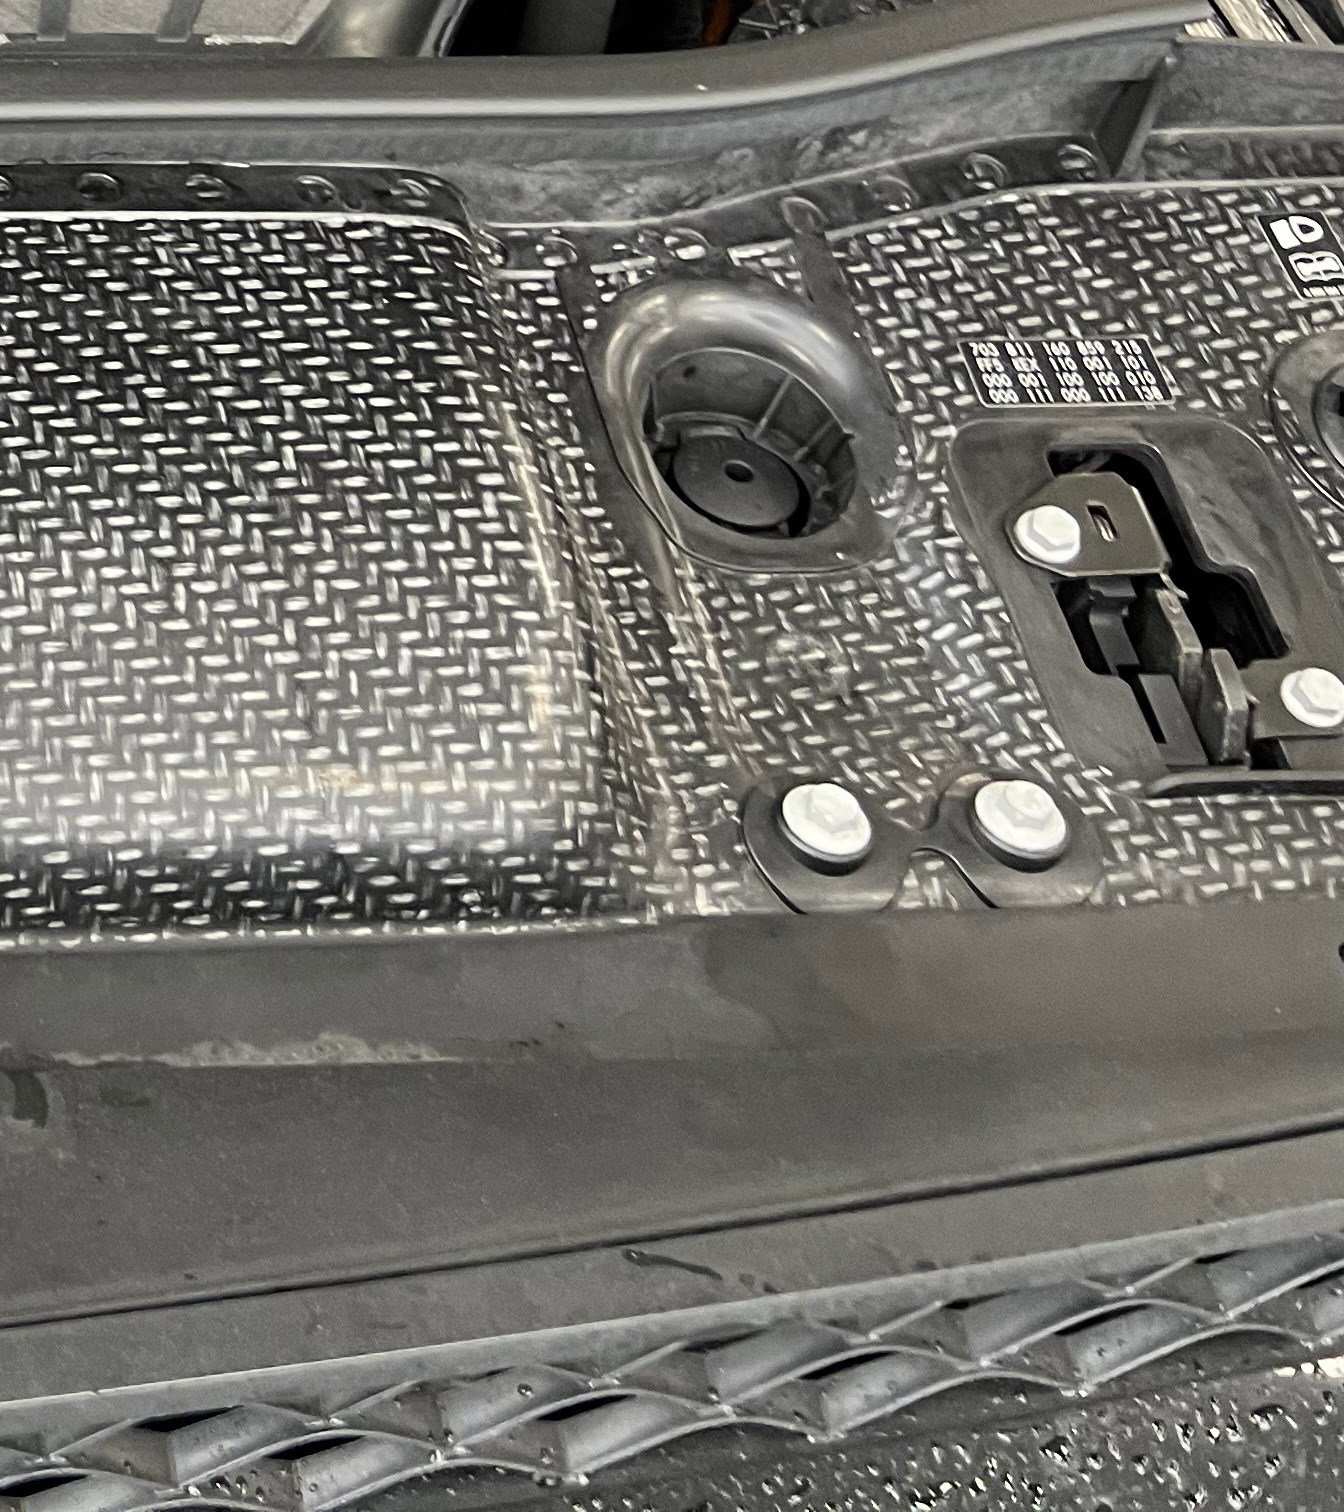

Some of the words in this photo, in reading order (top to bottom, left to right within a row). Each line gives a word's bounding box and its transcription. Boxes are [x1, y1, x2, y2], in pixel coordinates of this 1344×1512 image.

[969, 343, 1000, 358] 703
[1042, 342, 1071, 356] 160
[1049, 356, 1078, 371] 110
[1083, 356, 1112, 371] 001
[1120, 355, 1149, 370] 101
[981, 373, 1012, 388] 000
[1017, 373, 1047, 388] 001
[1056, 372, 1085, 387] 100
[1091, 372, 1120, 387] 100
[1125, 371, 1156, 386] 010
[989, 388, 1020, 403] 000
[1026, 388, 1055, 403] 111
[1061, 388, 1092, 403] 000
[1098, 387, 1126, 402] 111
